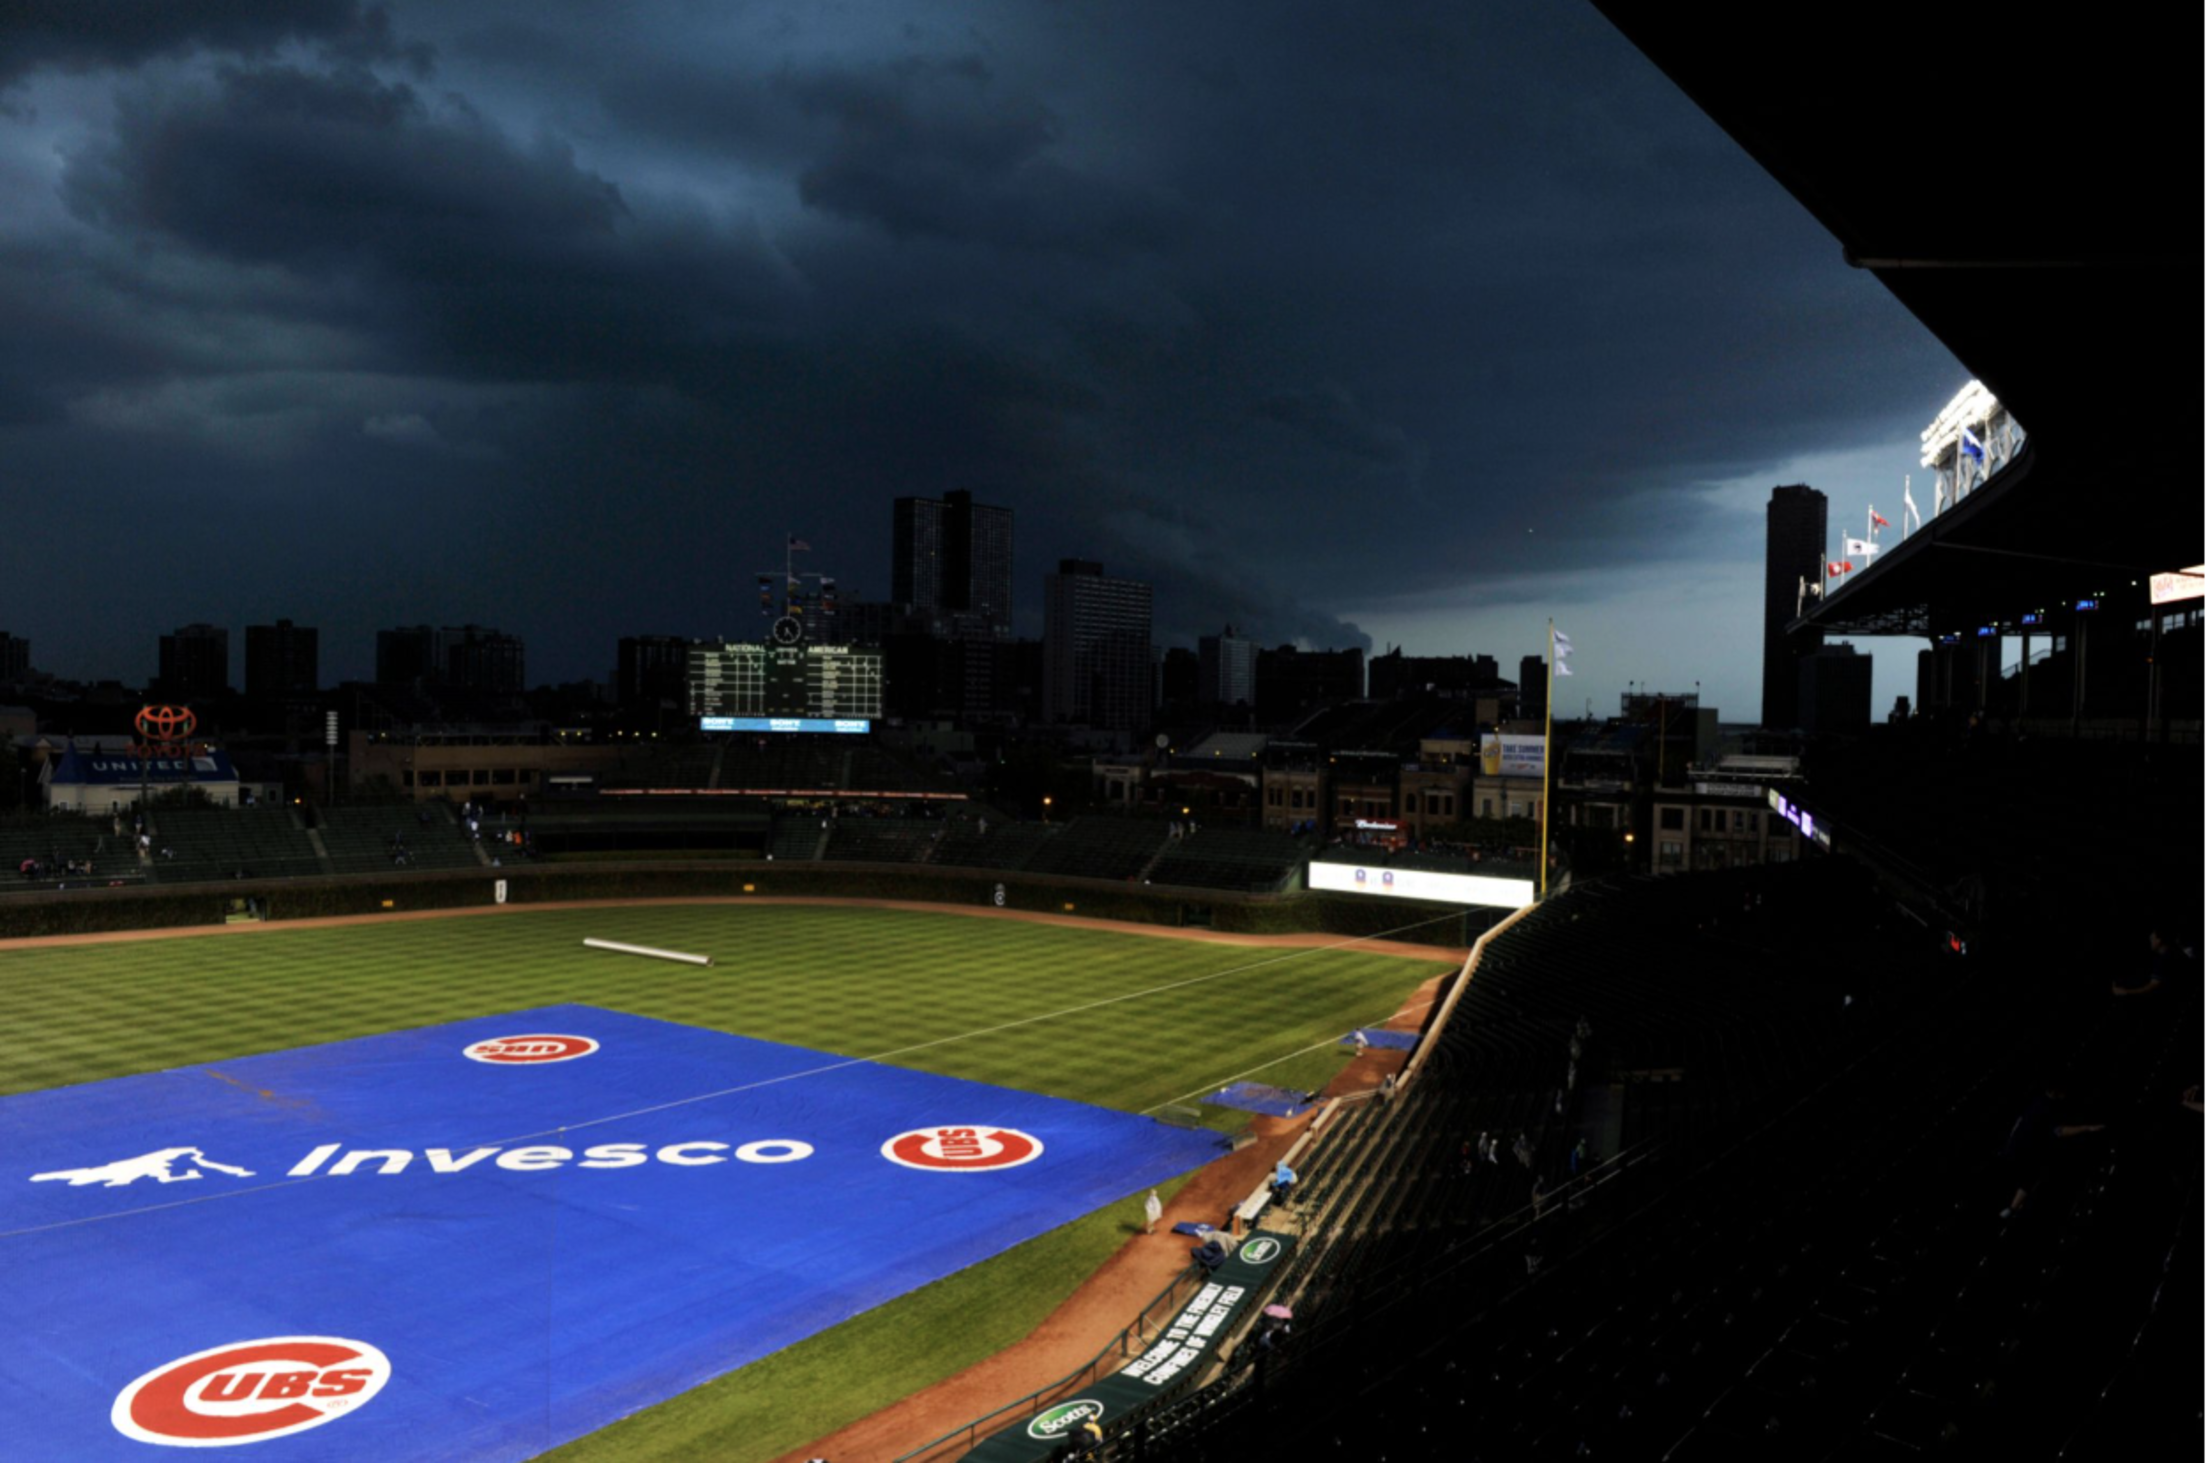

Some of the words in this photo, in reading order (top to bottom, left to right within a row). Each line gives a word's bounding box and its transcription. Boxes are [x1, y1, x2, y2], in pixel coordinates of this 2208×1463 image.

[725, 643, 765, 653] NATIONAL
[808, 646, 849, 655] AMERICAN
[287, 1139, 815, 1177] Invesco
[1174, 1312, 1200, 1330] THE
[1165, 1327, 1190, 1341] TO
[1185, 1335, 1208, 1350] OF
[1120, 1339, 1181, 1377] WELCOME
[130, 1342, 373, 1440] CUBS
[1040, 1404, 1091, 1434] Scotts
